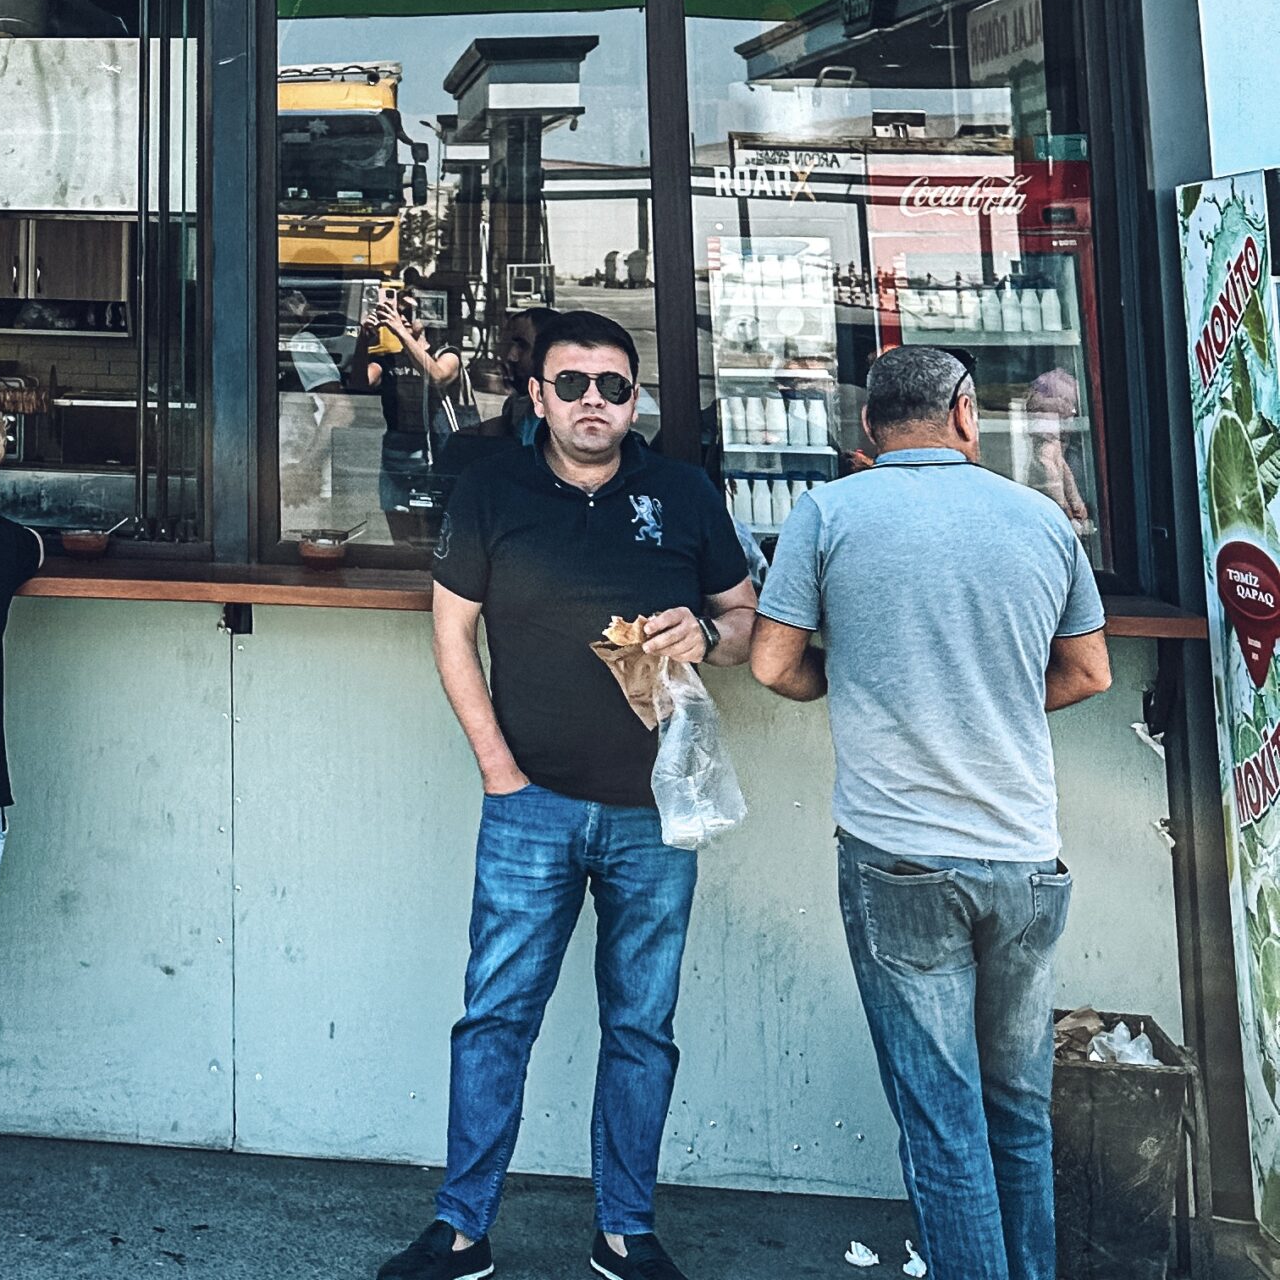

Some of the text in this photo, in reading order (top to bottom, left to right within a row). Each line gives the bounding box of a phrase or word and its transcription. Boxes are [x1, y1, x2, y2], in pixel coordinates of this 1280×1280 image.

[1194, 236, 1260, 388] MOXİTO
[1226, 568, 1260, 588] TƏMİZ
[1236, 584, 1275, 608] QAPAQ
